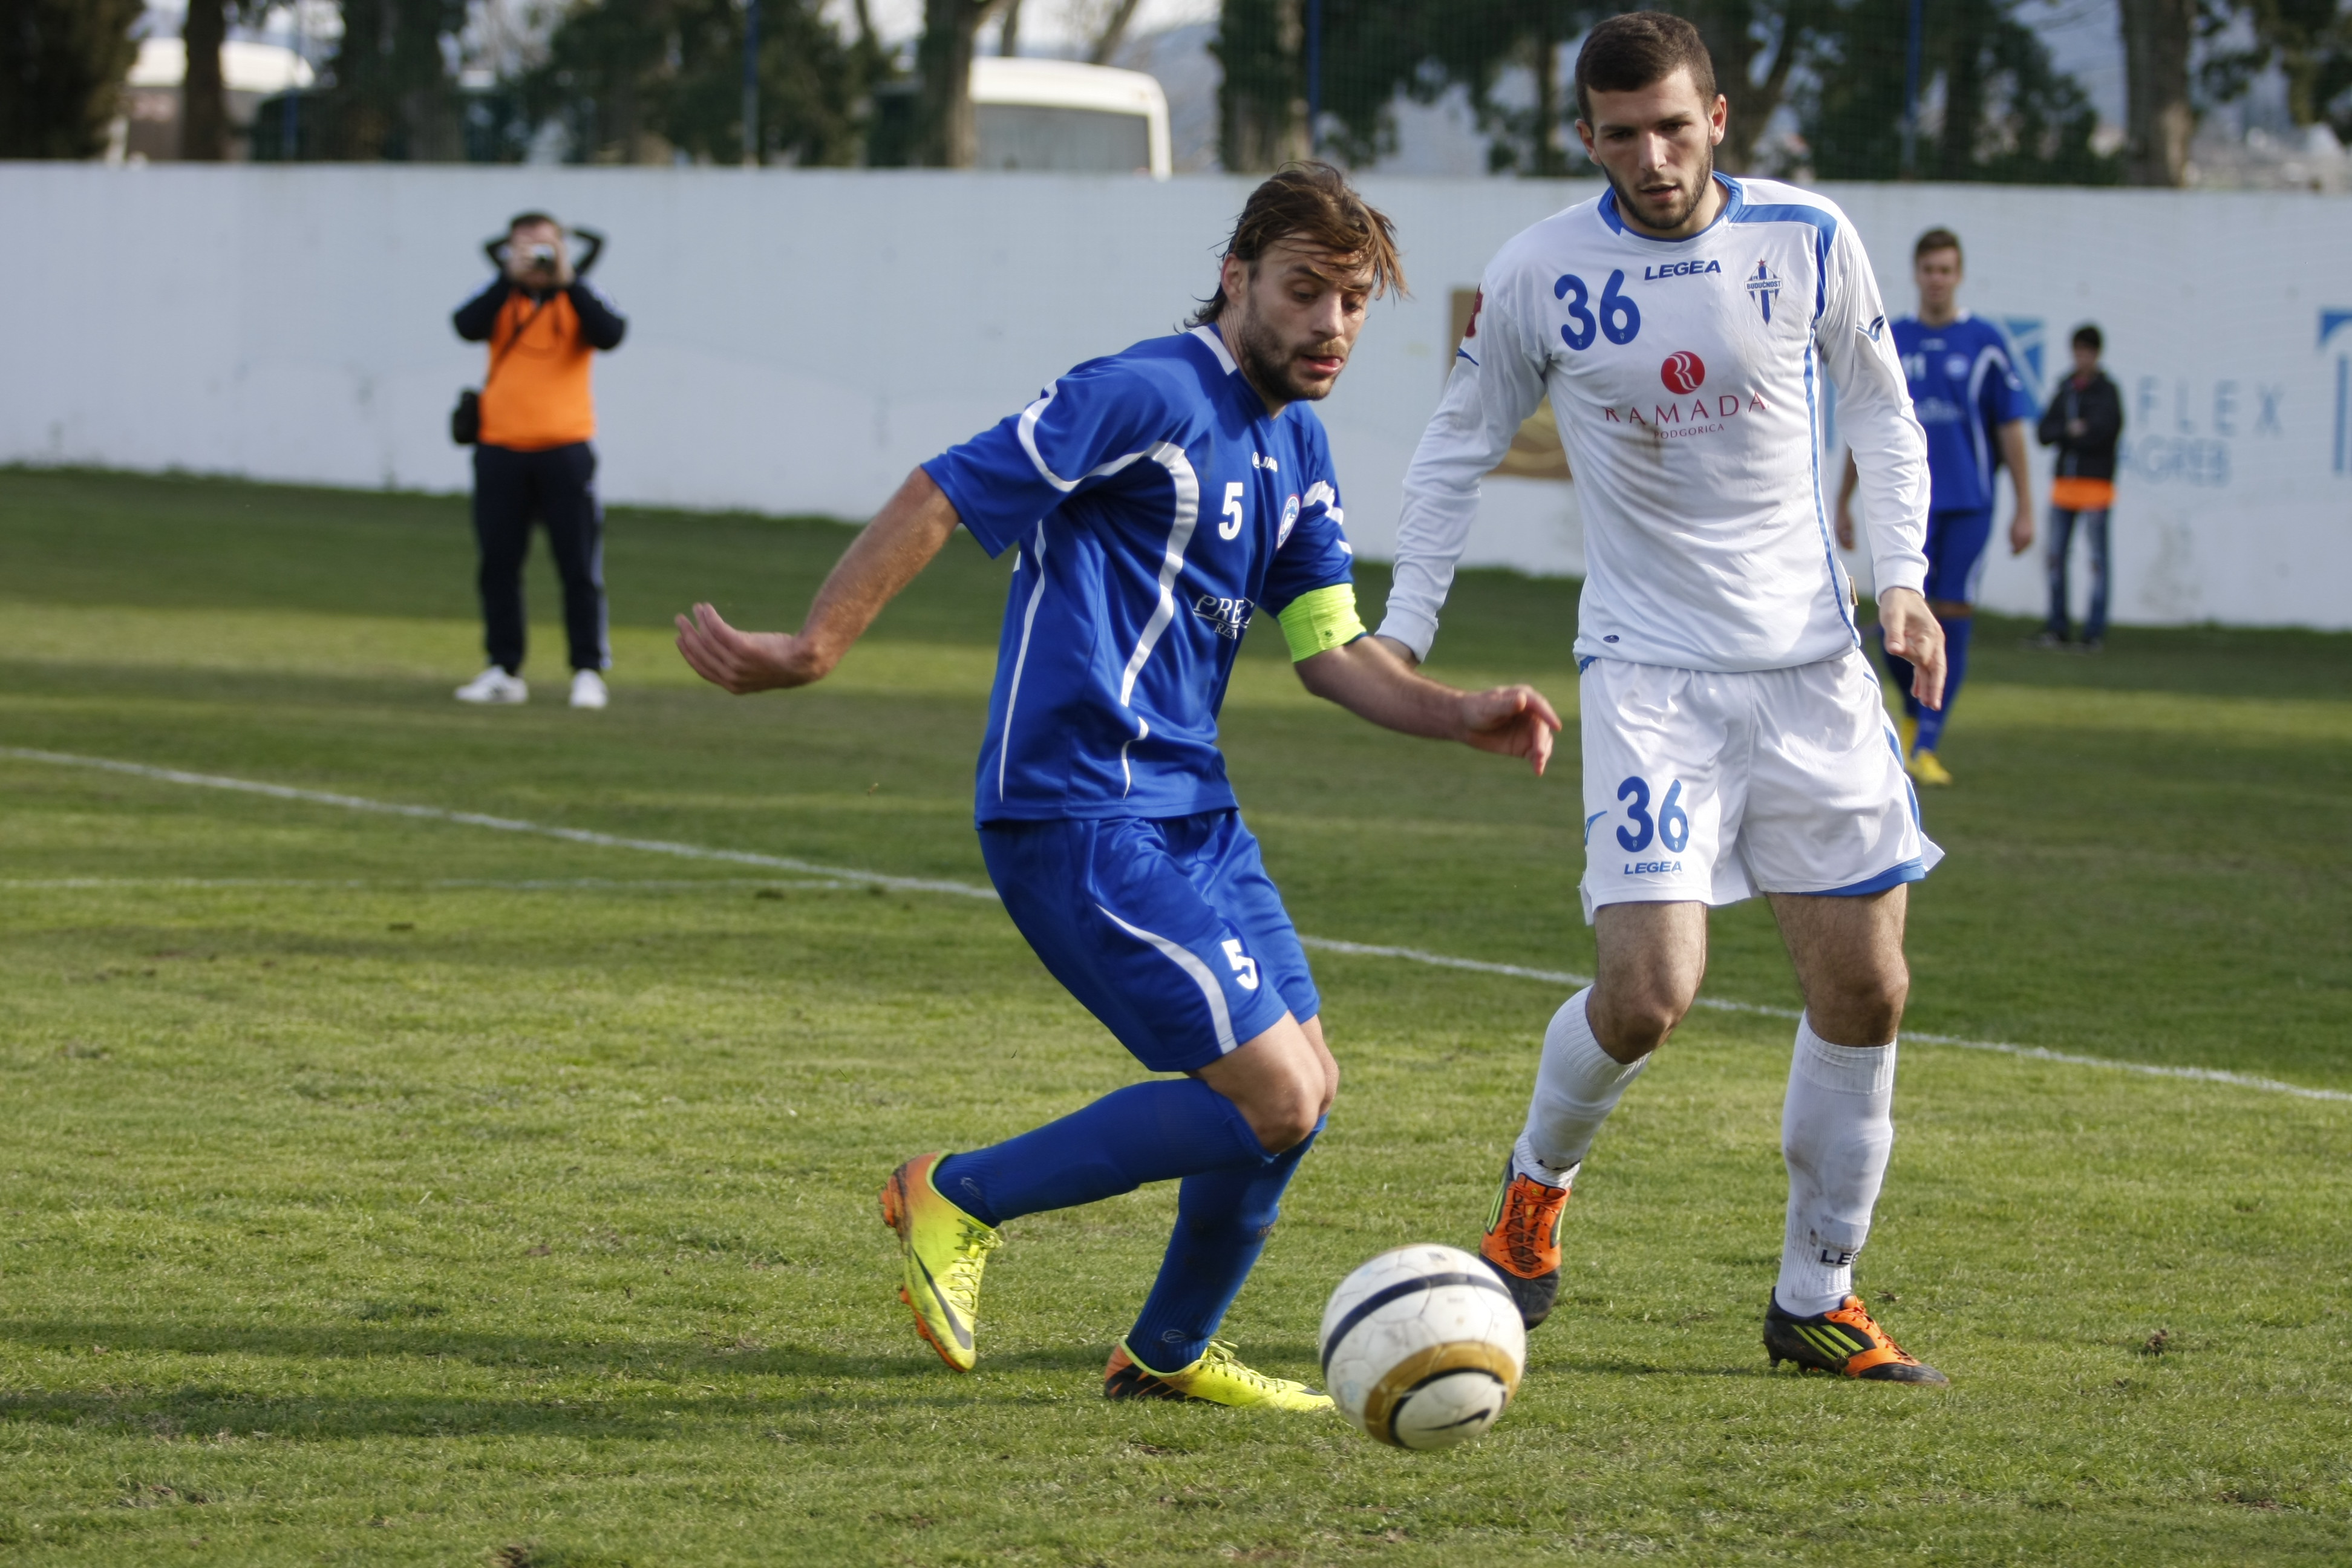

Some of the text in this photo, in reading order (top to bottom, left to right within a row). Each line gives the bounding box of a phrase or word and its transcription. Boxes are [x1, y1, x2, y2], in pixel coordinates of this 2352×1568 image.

[1644, 260, 1722, 281] LEGEA
[1554, 269, 1641, 351] 36
[1602, 391, 1766, 425] RAMADA
[1654, 423, 1724, 439] PODGORICA
[1218, 482, 1243, 540] 5
[1616, 776, 1689, 853] 36
[1624, 861, 1683, 875] LEGEA
[1221, 939, 1259, 990] 5
